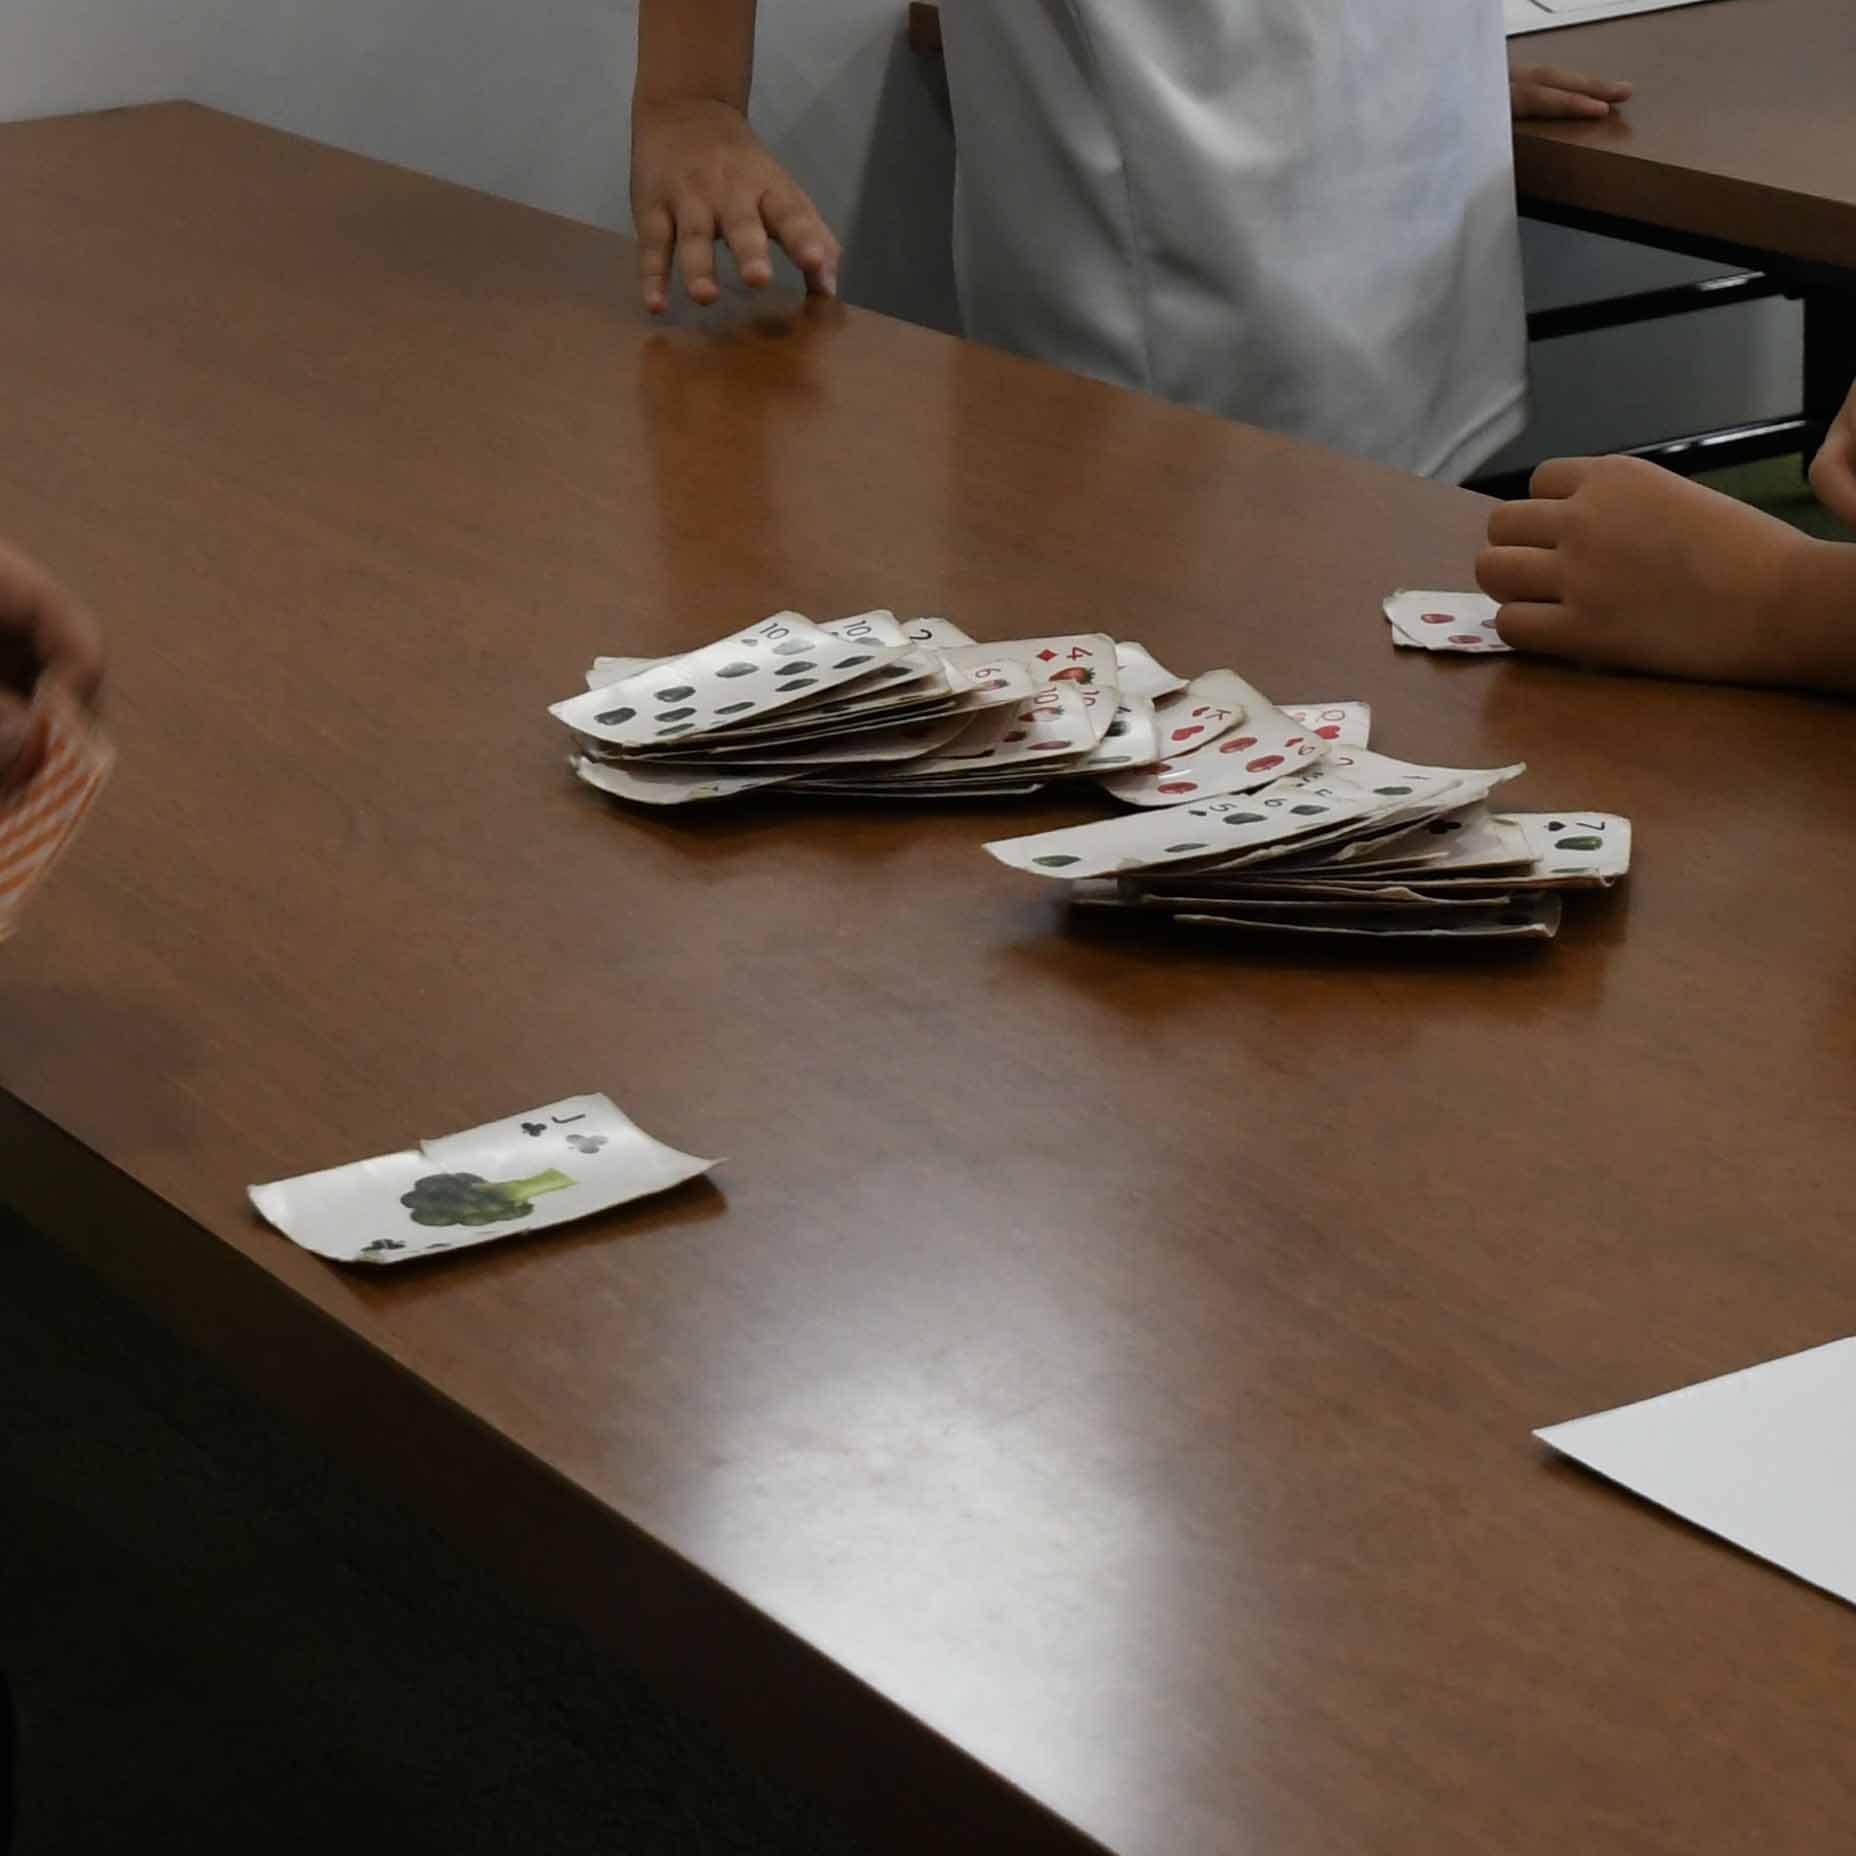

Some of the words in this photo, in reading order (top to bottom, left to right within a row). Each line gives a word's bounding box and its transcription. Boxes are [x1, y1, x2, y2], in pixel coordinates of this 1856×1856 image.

[760, 621, 790, 641] 10
[844, 619, 872, 637] 10
[1066, 646, 1093, 662] 4
[1034, 686, 1059, 706] 10
[1205, 708, 1231, 721] K
[1209, 802, 1238, 813] 5
[1576, 821, 1606, 831] 7
